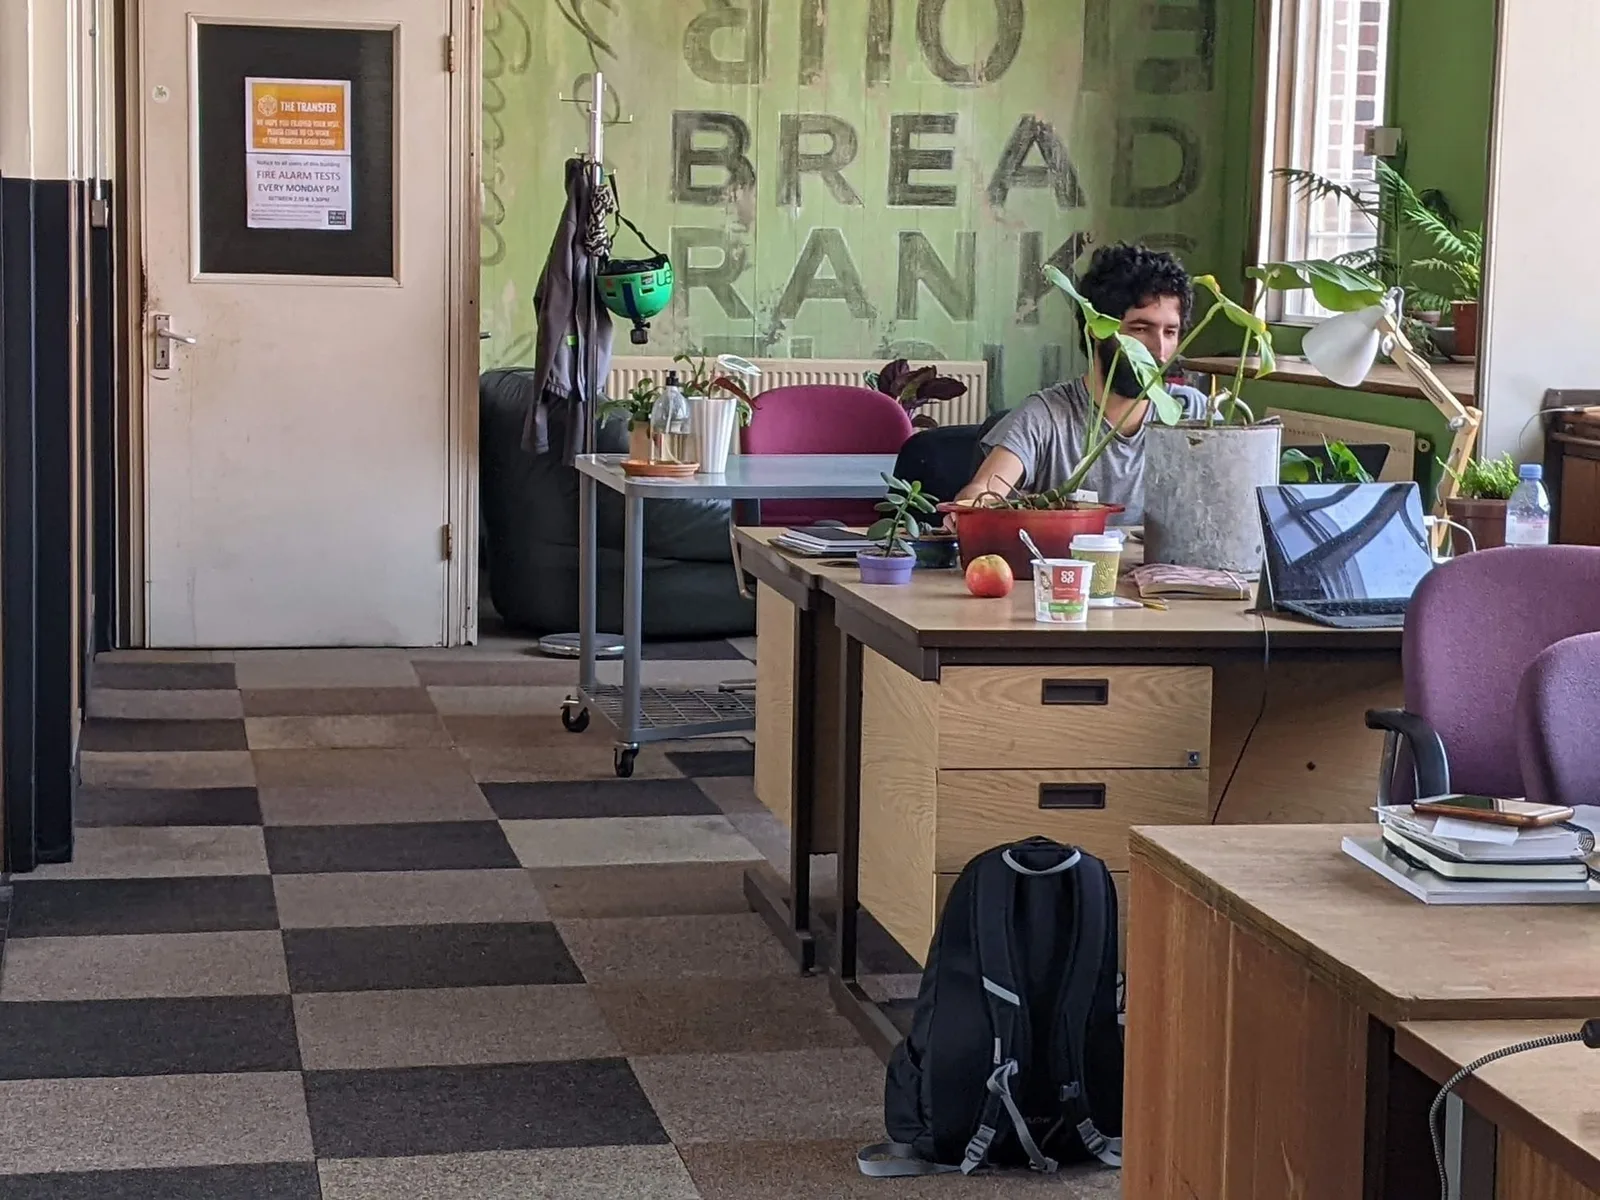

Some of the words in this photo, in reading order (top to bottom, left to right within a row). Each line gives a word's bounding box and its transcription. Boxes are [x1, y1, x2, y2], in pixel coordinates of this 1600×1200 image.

[280, 102, 295, 112] THE
[297, 102, 337, 113] TRANSFER
[669, 111, 1205, 209] BREAD
[256, 170, 276, 179] FIRE
[278, 171, 312, 180] ALARM
[314, 172, 341, 181] TESTS
[258, 183, 284, 192] EVERY
[286, 184, 324, 193] MONDAY
[326, 185, 340, 193] PM
[669, 226, 1199, 326] RANK
